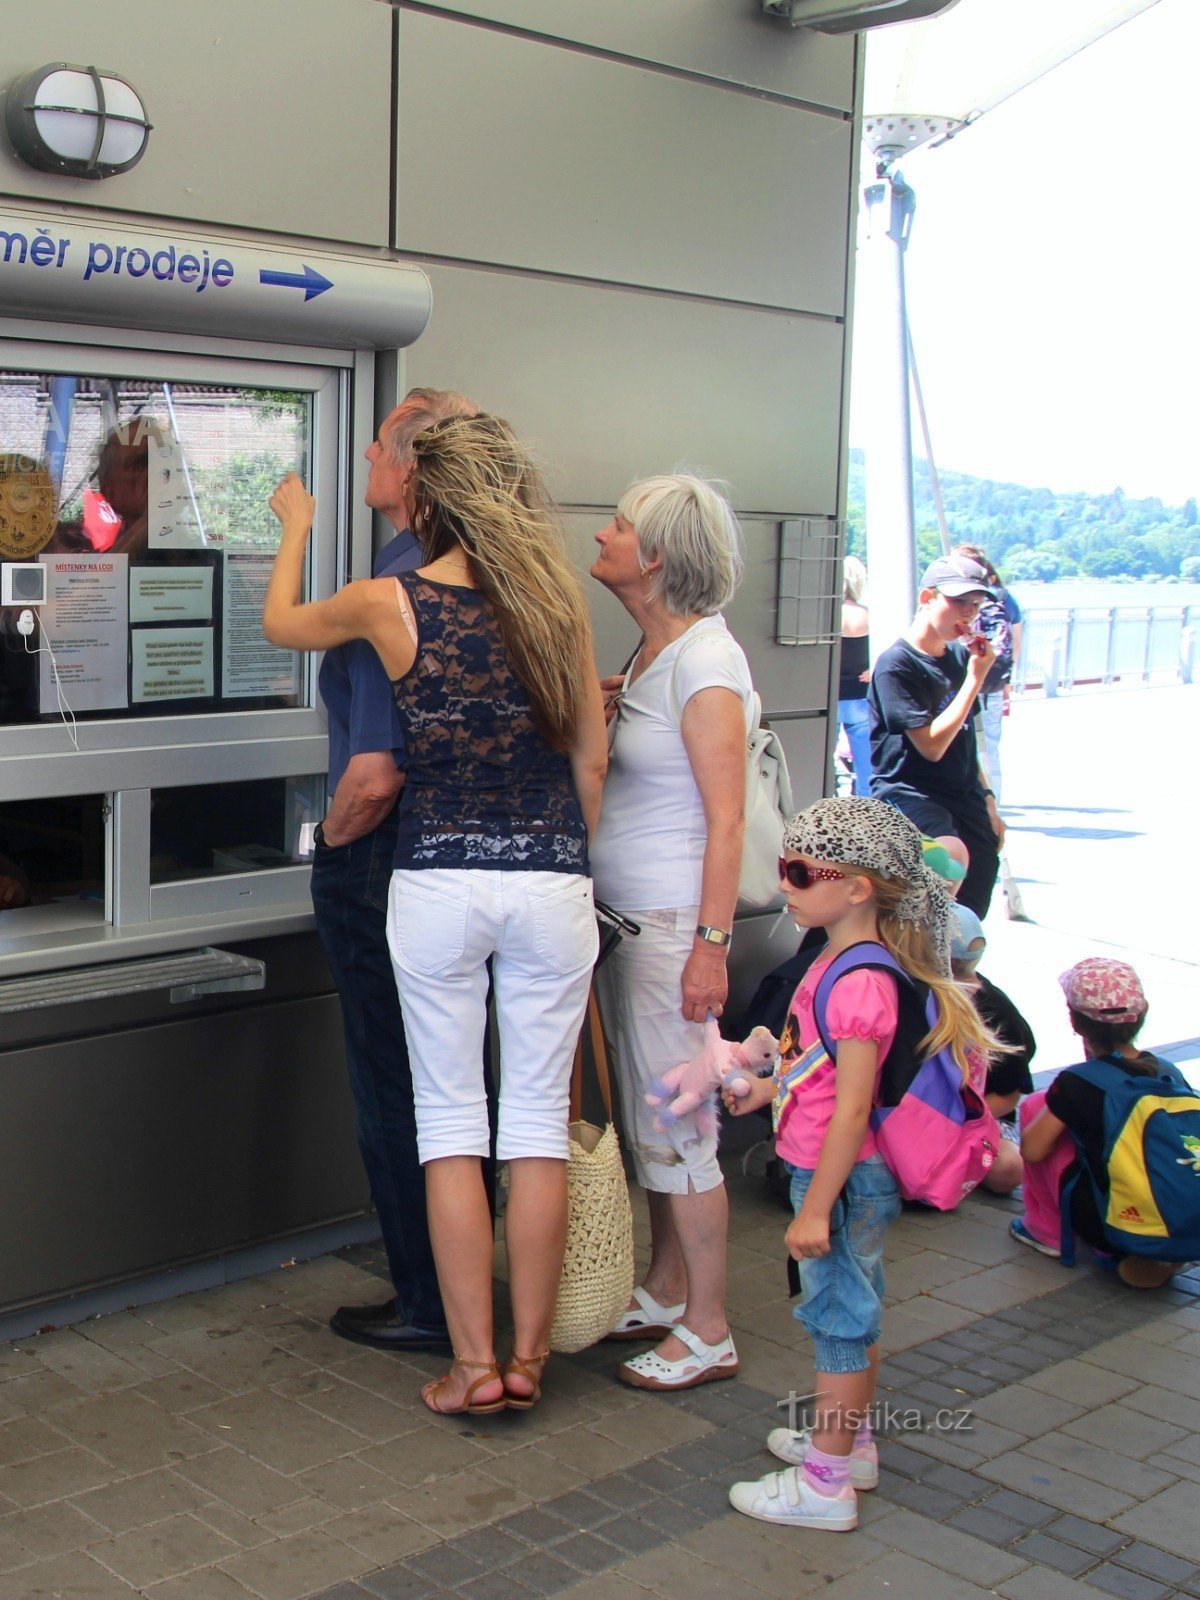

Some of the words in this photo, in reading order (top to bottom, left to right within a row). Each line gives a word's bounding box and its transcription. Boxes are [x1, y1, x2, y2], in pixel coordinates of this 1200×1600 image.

[83, 242, 234, 293] prodeje
[55, 563, 87, 572] MÍSTENKY
[88, 564, 98, 572] NA
[98, 564, 114, 572] LODI
